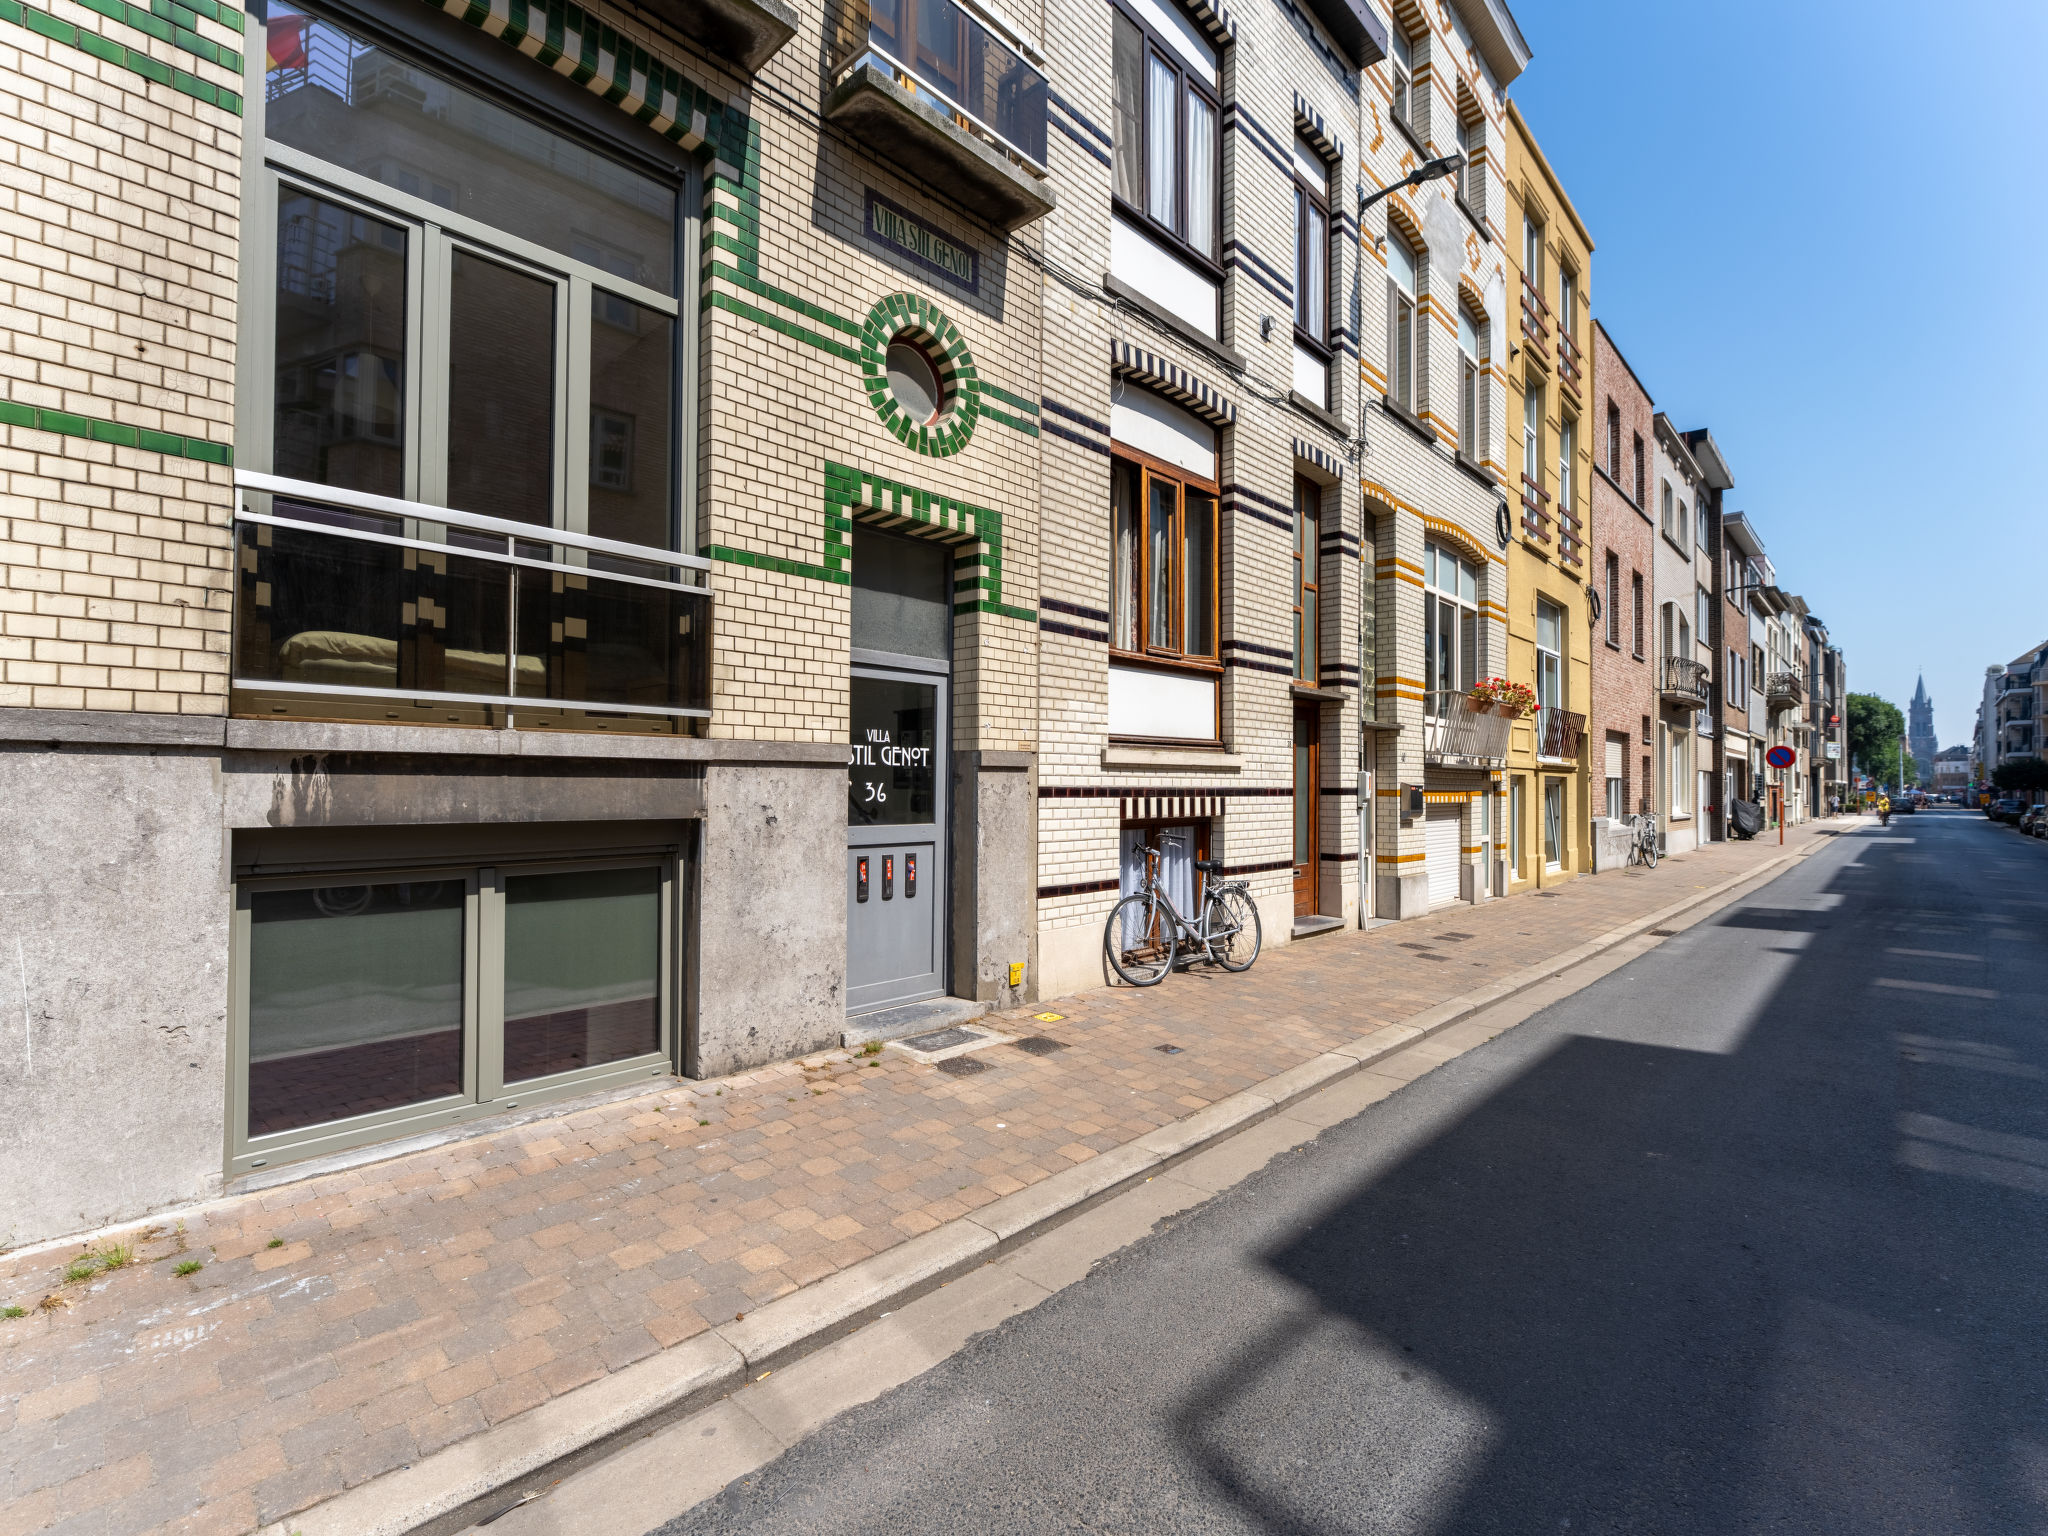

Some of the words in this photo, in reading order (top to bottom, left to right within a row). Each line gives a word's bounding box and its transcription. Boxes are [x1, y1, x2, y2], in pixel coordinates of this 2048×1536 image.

[866, 728, 891, 743] VILLA
[881, 746, 930, 767] GENOT
[865, 782, 887, 802] 36
